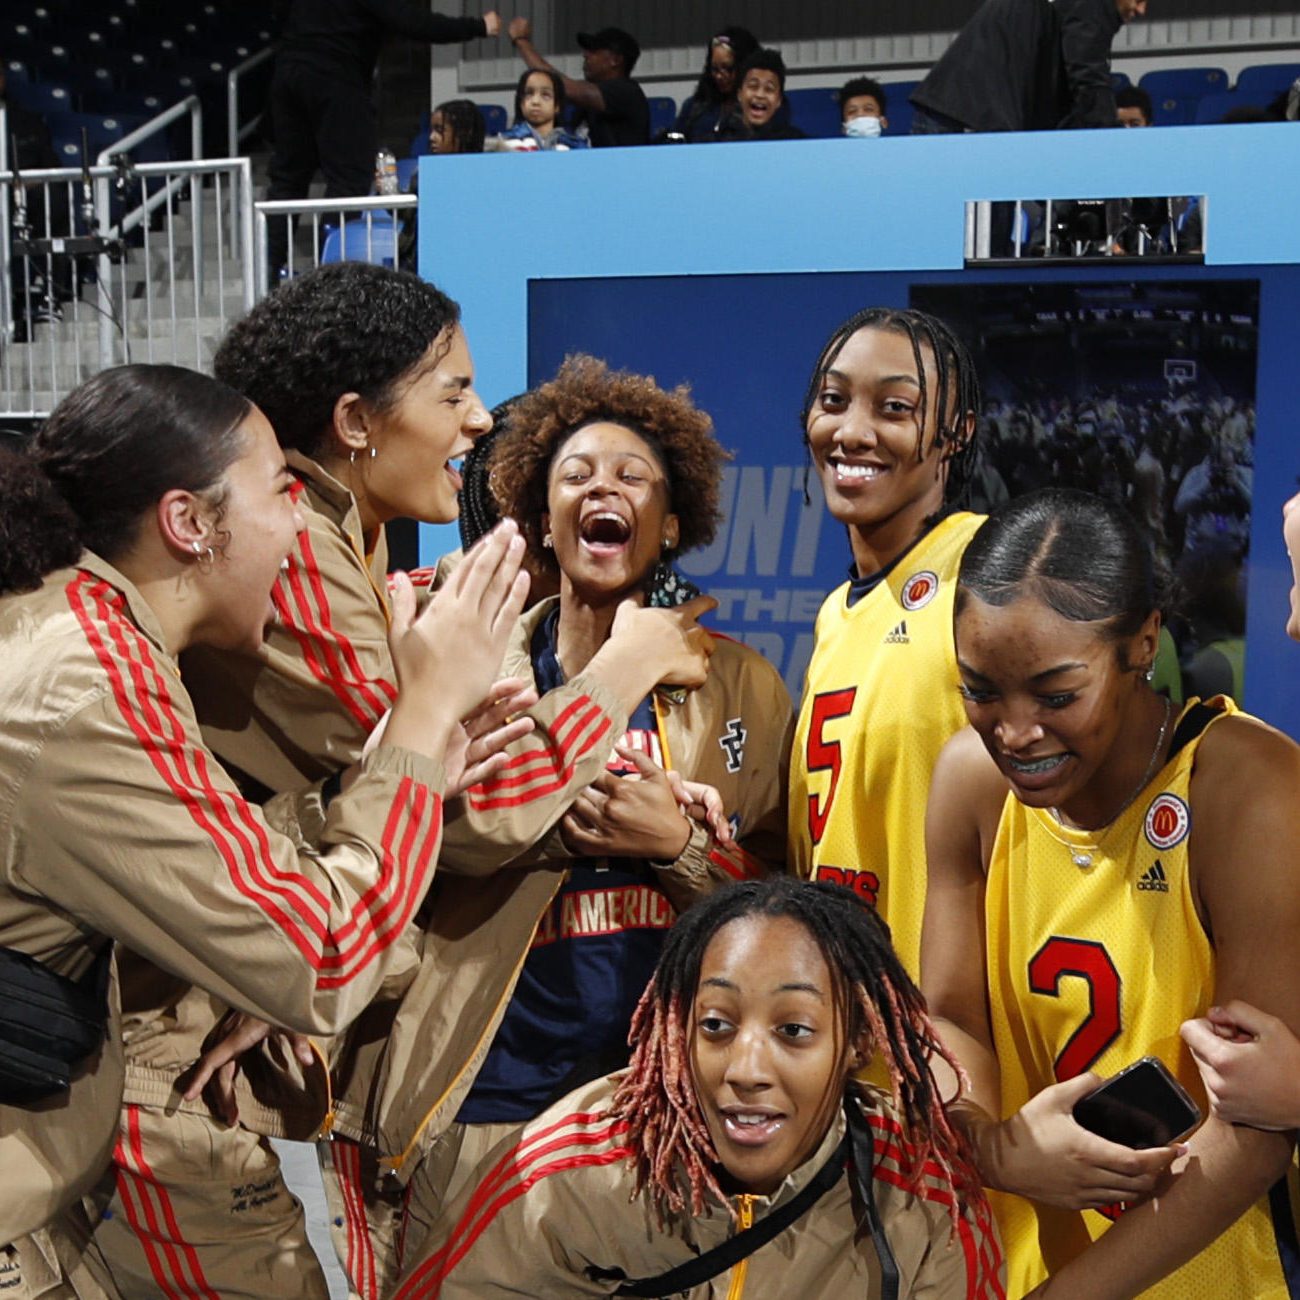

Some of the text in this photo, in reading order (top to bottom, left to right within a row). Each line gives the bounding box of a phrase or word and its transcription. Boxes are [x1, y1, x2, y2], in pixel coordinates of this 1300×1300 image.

[707, 589, 827, 622] THE
[806, 686, 857, 845] 5
[1028, 935, 1122, 1083] 2
